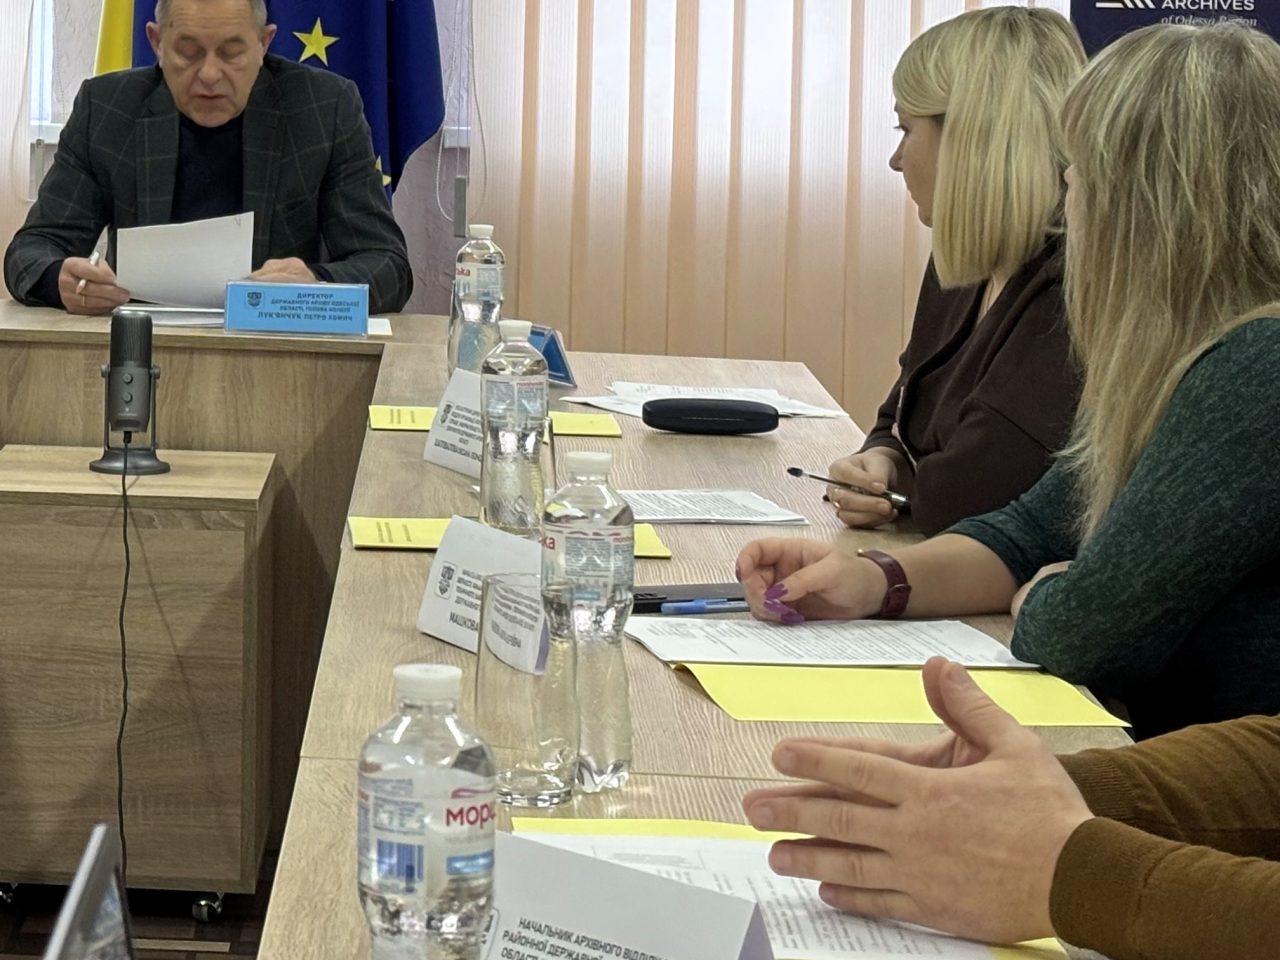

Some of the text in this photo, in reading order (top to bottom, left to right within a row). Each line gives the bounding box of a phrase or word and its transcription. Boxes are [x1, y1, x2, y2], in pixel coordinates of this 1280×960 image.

[297, 292, 333, 300] ДИРЕКТОР
[304, 313, 327, 321] ПЕТРО
[518, 917, 573, 942] НАЧАЛЬНИК
[502, 929, 547, 953] РАЙОННОЇ
